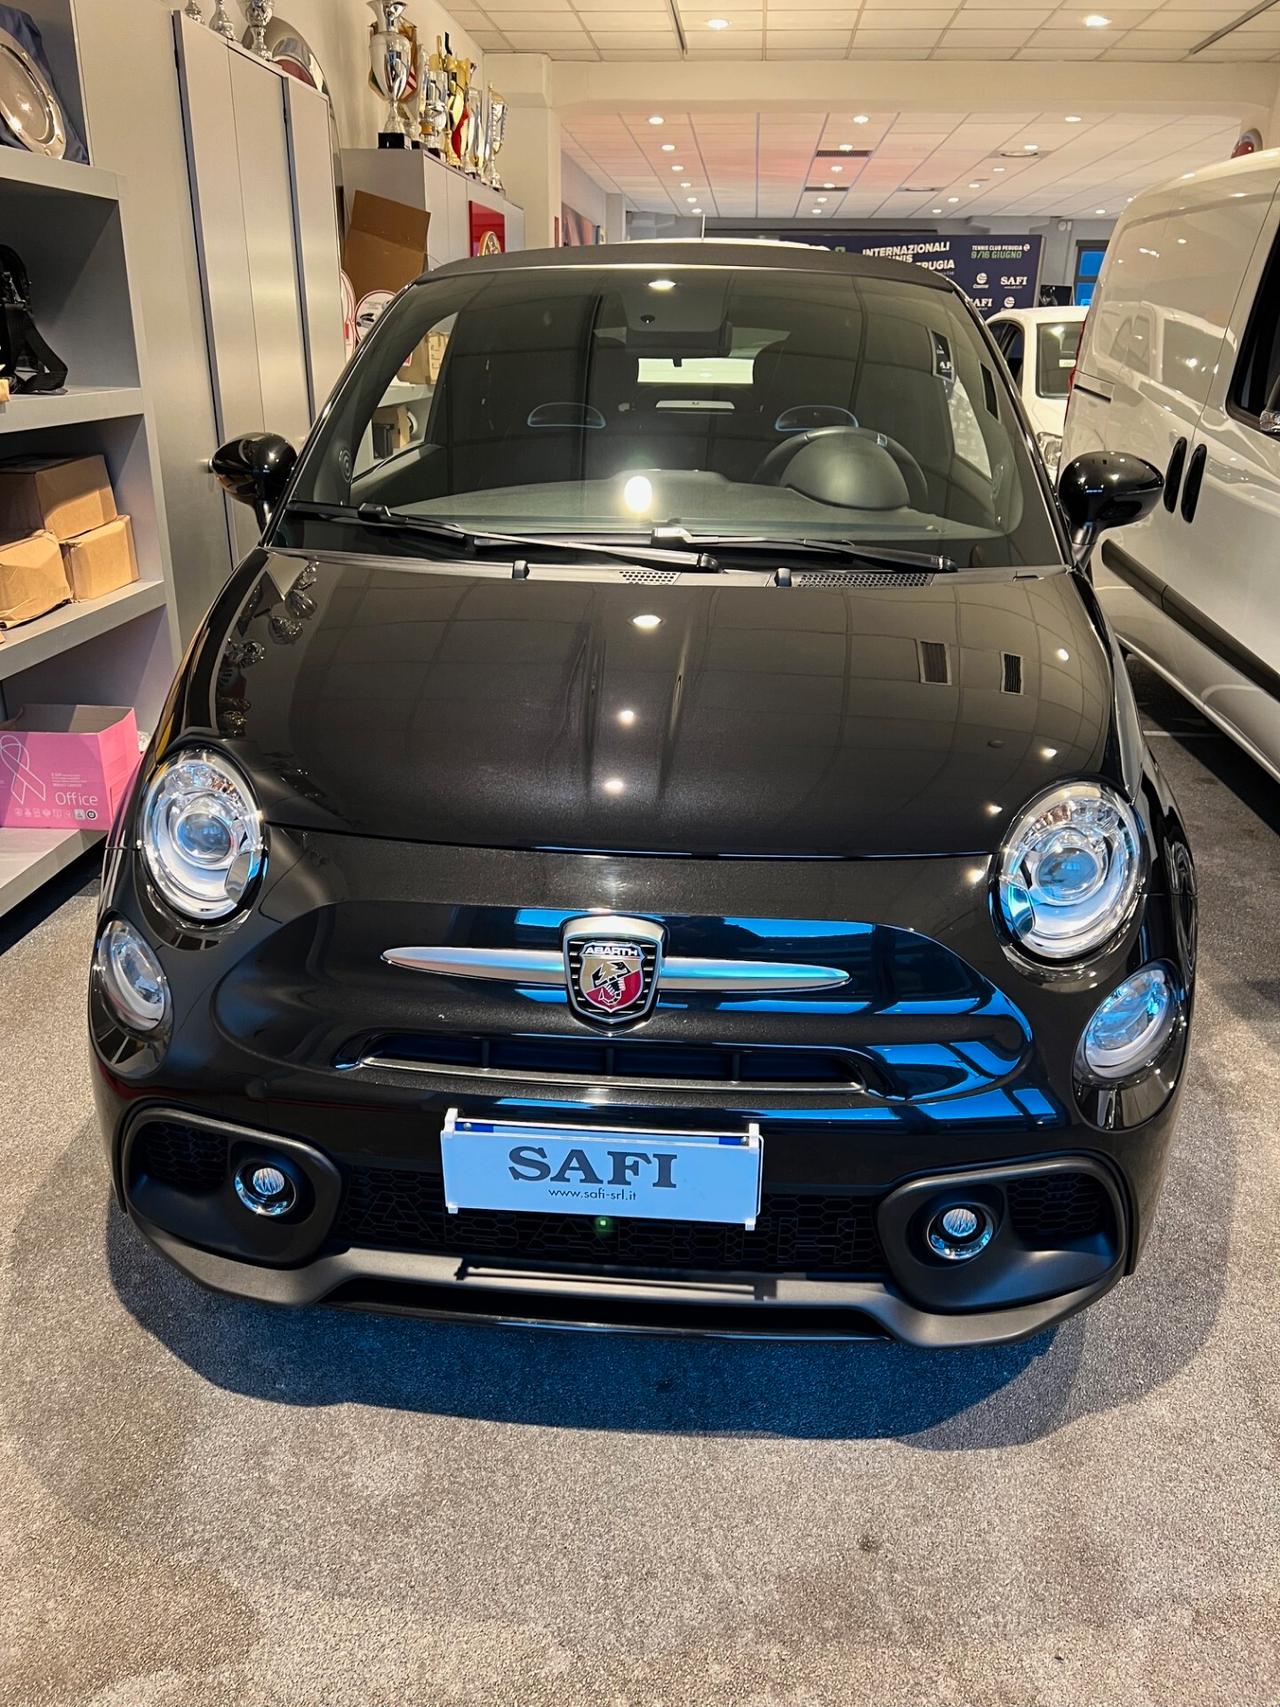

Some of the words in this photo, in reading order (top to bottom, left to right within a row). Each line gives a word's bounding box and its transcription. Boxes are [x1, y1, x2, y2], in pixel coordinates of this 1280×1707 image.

[862, 241, 950, 257] INTERNAZIONALI
[991, 251, 1022, 259] GIUGNO
[916, 259, 955, 270] RUGIA
[1000, 276, 1028, 286] SAFI
[971, 298, 993, 307] AFI
[55, 791, 98, 806] Office
[584, 946, 639, 957] ABARTH
[508, 1145, 677, 1189] SAFI
[548, 1187, 637, 1201] www.safi-srl.it
